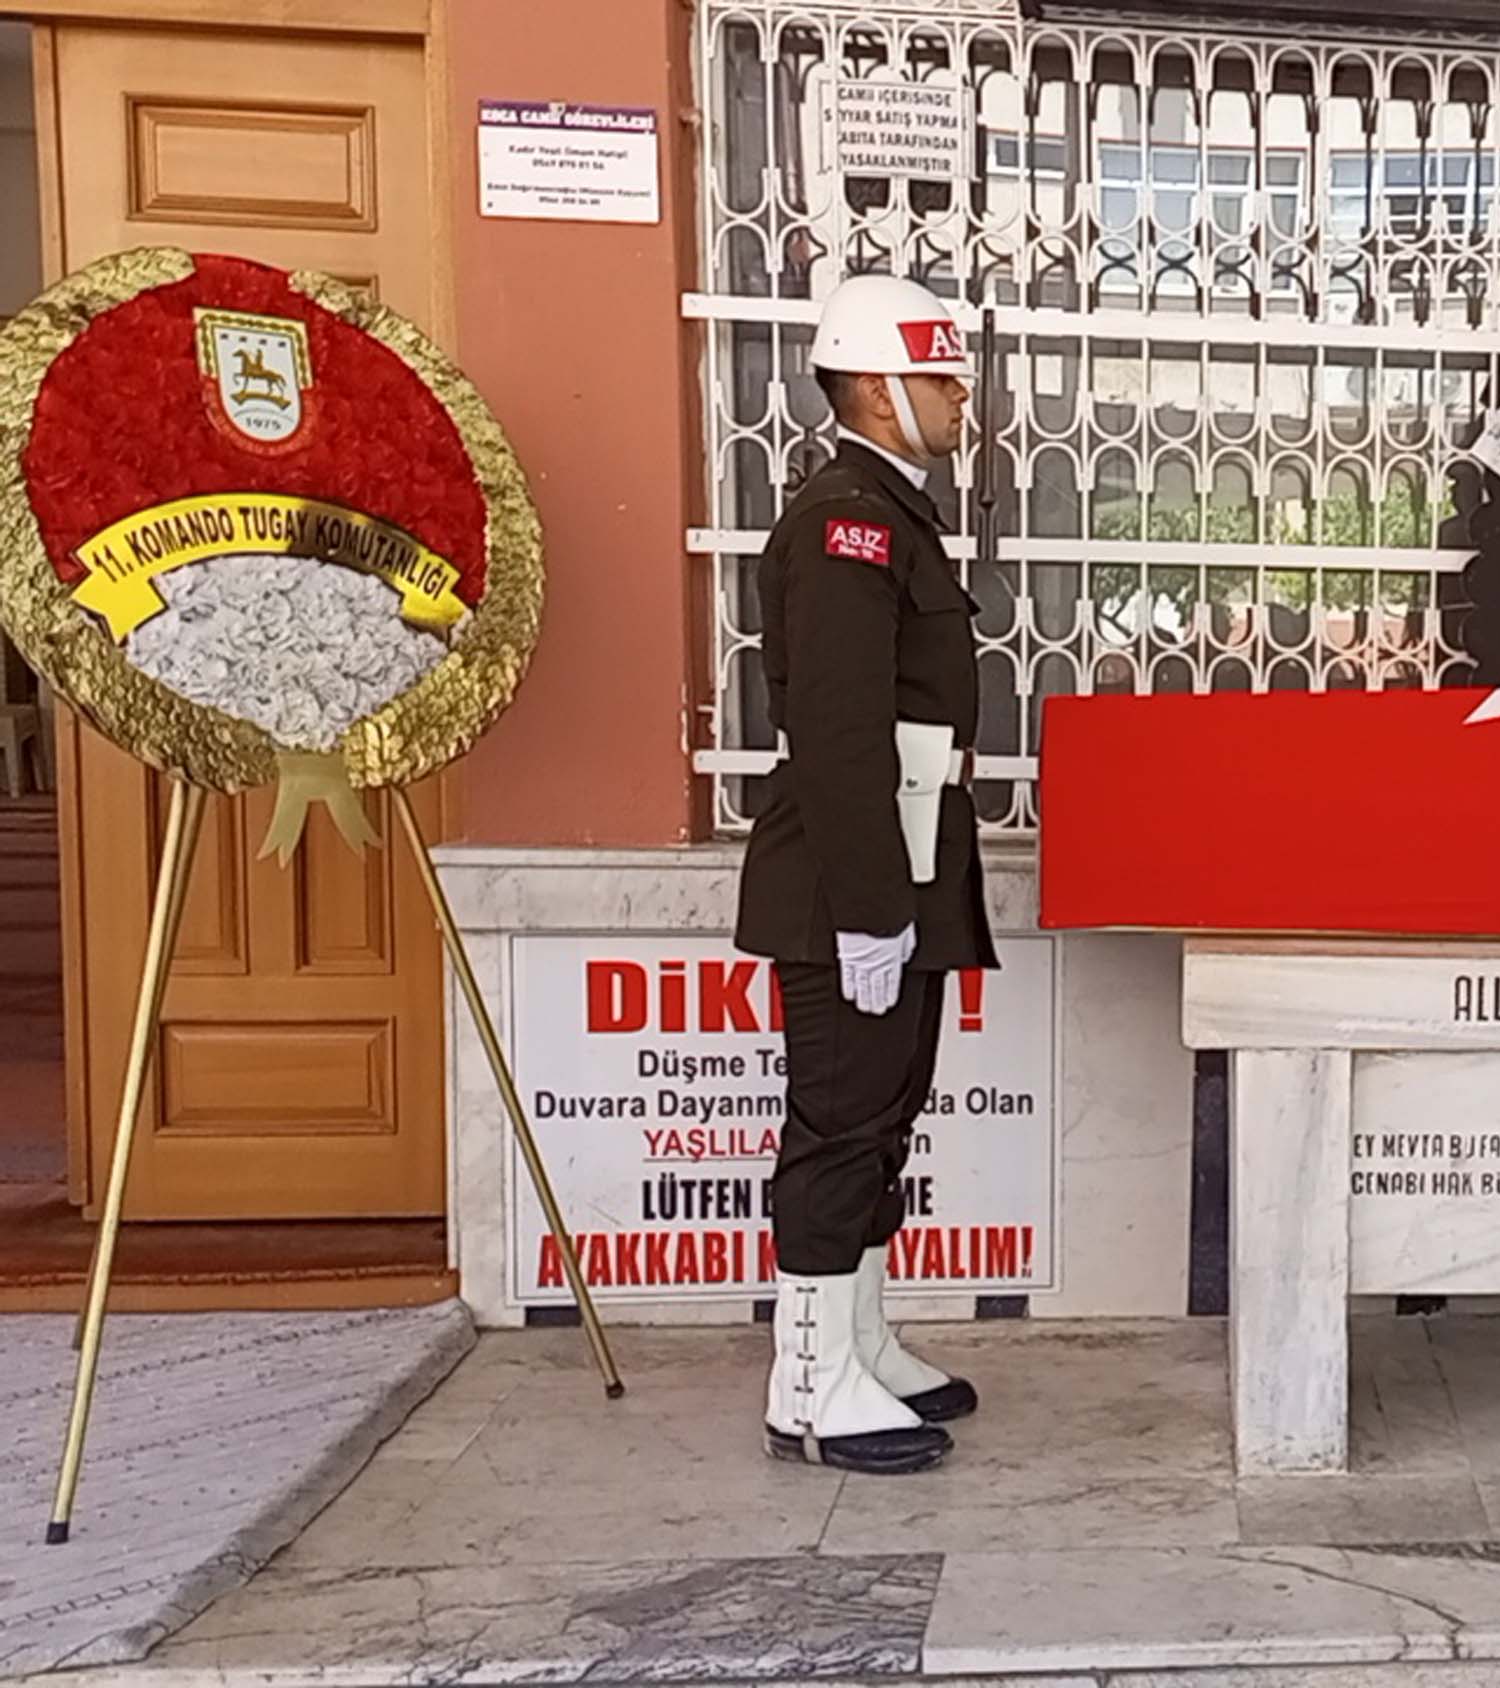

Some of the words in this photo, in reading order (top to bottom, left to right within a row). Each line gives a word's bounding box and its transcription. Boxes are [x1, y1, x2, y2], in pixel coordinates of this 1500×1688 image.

[93, 544, 134, 584] 11.
[124, 507, 235, 566] KOMANDO
[237, 506, 309, 543] TUGAY
[314, 514, 449, 601] KOMUTANLIĞI
[638, 1048, 746, 1084] Düşme
[535, 1090, 646, 1119] Duvara
[966, 1086, 1034, 1116] Olan
[1353, 1134, 1376, 1159] EY
[642, 1171, 752, 1220] LÜTFEN
[1432, 1171, 1474, 1196] HAK
